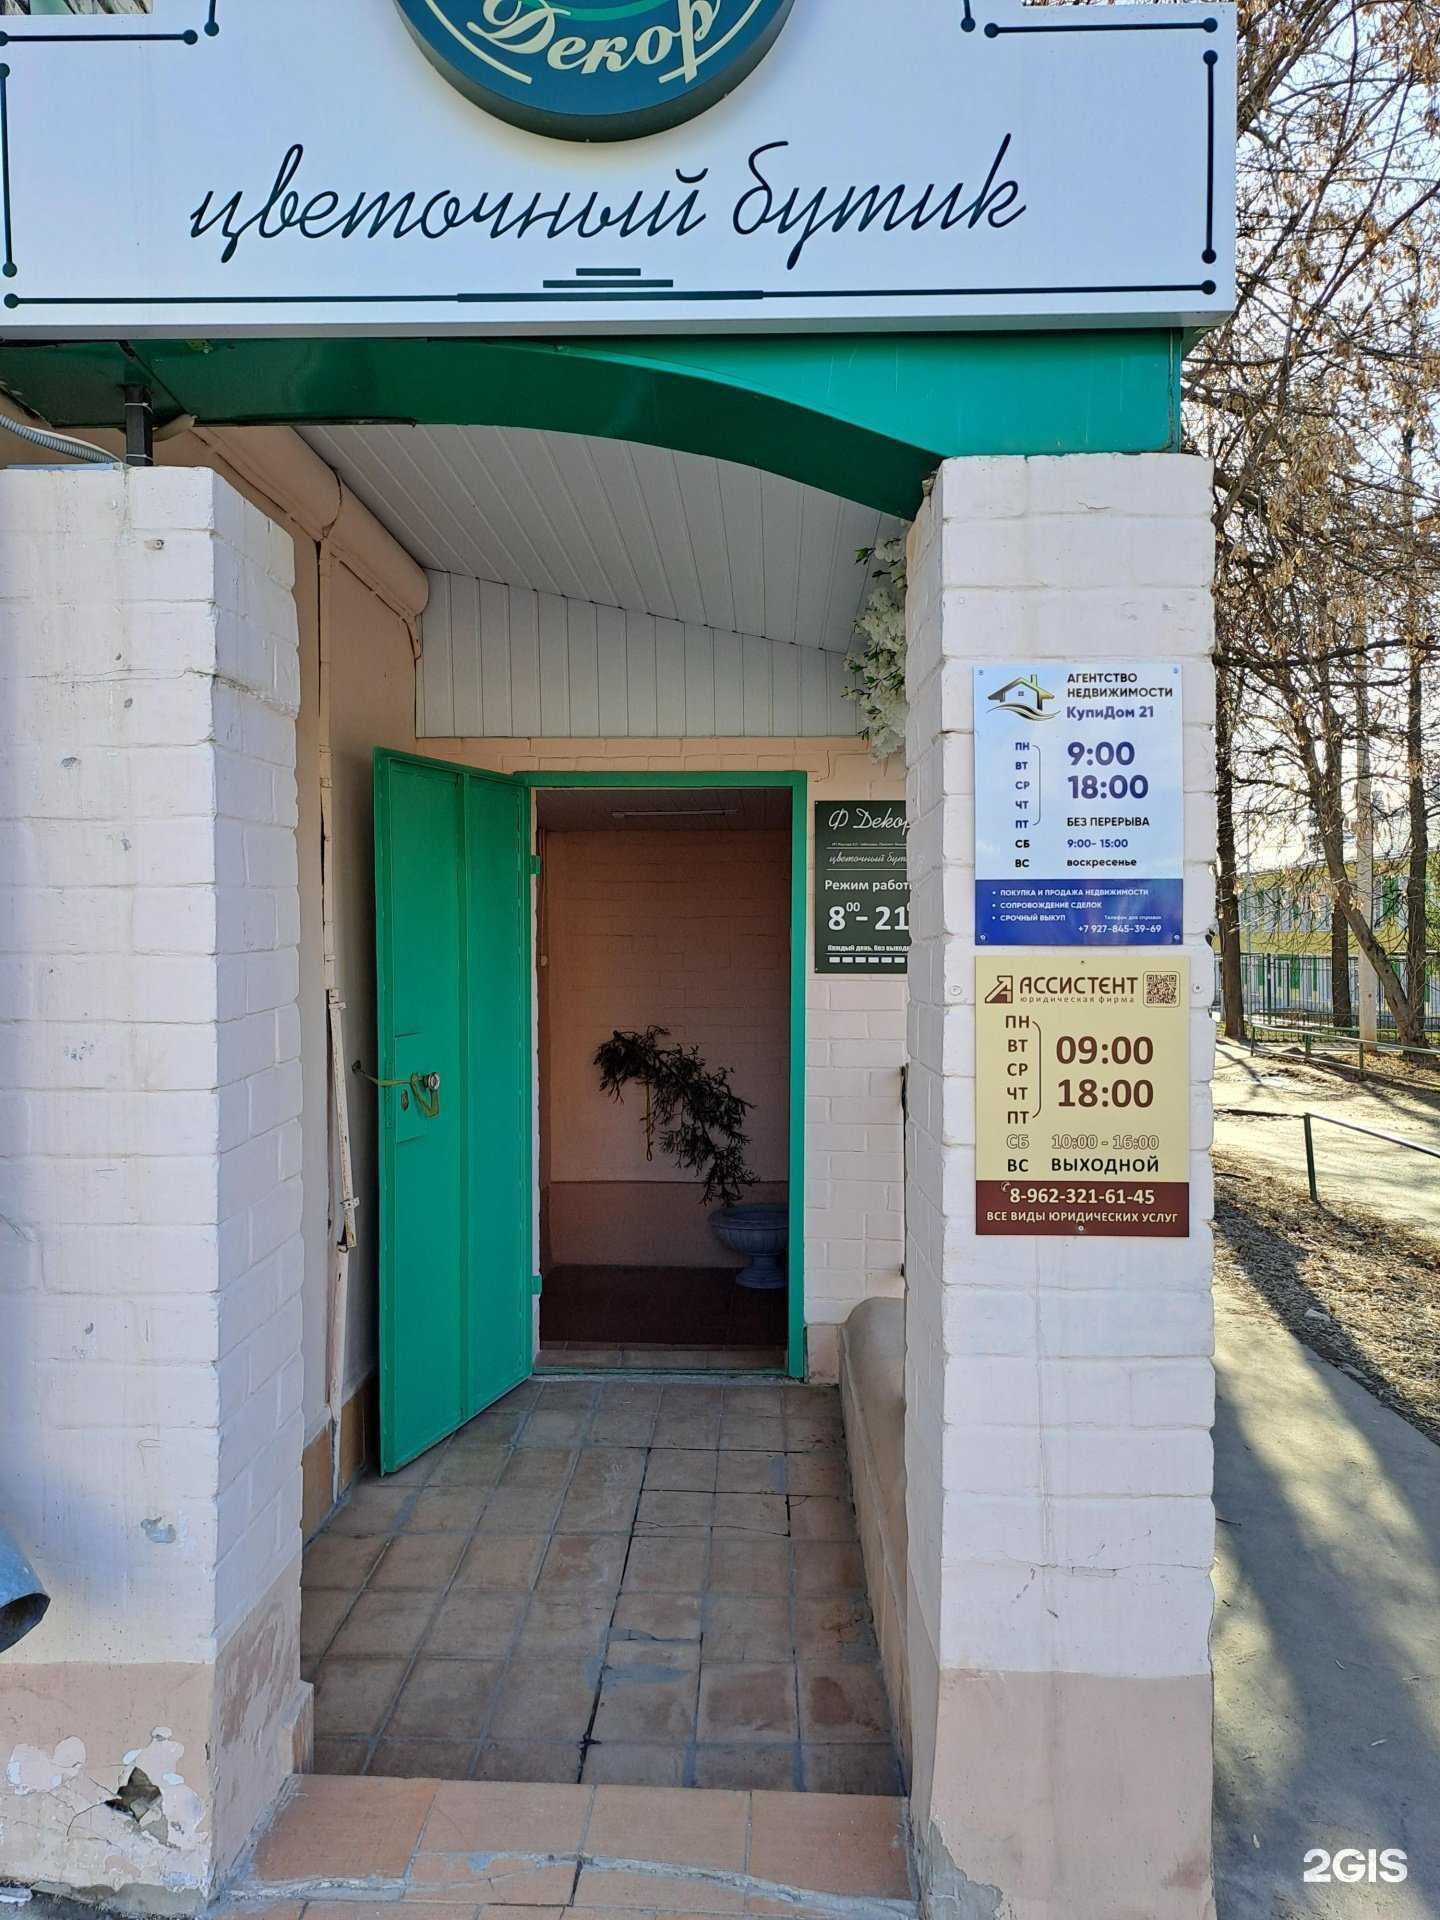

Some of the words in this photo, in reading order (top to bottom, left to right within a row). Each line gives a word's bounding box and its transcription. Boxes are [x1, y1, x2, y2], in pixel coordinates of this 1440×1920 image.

[467, 0, 722, 83] Декор
[190, 143, 707, 263] цветочный
[733, 132, 1027, 269] бутик
[1067, 672, 1138, 684] АГЕНТСТВО
[1067, 687, 1174, 699] НЕДВИЖИМОСТИ
[1066, 705, 1135, 721] КупиДом
[1138, 705, 1155, 718] 21
[1015, 742, 1030, 751] ПН
[1066, 741, 1136, 766] 9:00
[1015, 761, 1028, 770] ВТ
[1015, 781, 1030, 790] СР
[1066, 774, 1149, 800] 18:00
[1015, 800, 1029, 810] ЧТ
[828, 808, 849, 830] Ф
[1015, 820, 1029, 829] ПТ
[1066, 817, 1087, 827] БЕЗ
[1090, 817, 1150, 827] ПЕРЕРЫВА
[1015, 839, 1030, 849] СБ
[1100, 838, 1129, 849] 15:00
[829, 851, 886, 865] цветочный
[887, 851, 907, 866] бут
[1015, 859, 1030, 868] ВС
[1066, 858, 1137, 868] воскресенье
[825, 879, 869, 891] Режим
[872, 879, 912, 893] работ
[1000, 889, 1036, 897] ПОКУПКА
[1045, 889, 1083, 897] ПРОДАЖА
[1085, 888, 1149, 897] НЕДВИЖИМОСТИ
[1000, 901, 1069, 910] СОПРОВОЖДЕНИЕ
[1071, 901, 1103, 910] СДЕЛОК
[1000, 913, 1038, 922] СРОЧНЫЙ
[1039, 914, 1066, 922] ВЫКУП
[1078, 925, 1089, 933] +7
[1091, 924, 1162, 934] 927-845-39-69
[886, 944, 909, 953] выход
[1019, 976, 1138, 995] АССИСТЕНТ
[1020, 996, 1095, 1005] юридическая
[1098, 995, 1135, 1005] фирма
[1005, 1015, 1030, 1029] ПН
[1007, 1039, 1028, 1053] ВТ
[1056, 1036, 1154, 1065] 09:00
[1007, 1063, 1028, 1076] СР
[1007, 1087, 1028, 1101] ЧТ
[1057, 1079, 1154, 1108] 18:00
[1007, 1111, 1030, 1125] ПТ
[1006, 1134, 1030, 1149] СБ
[1051, 1134, 1098, 1150] 10:00
[1112, 1134, 1159, 1150] 16:00
[1007, 1158, 1029, 1173] ВС
[1051, 1155, 1159, 1175] ВЫХОДНОЙ
[1010, 1188, 1155, 1205] 8-962-321-61-45
[986, 1211, 1008, 1222] ВСЕ
[1010, 1211, 1046, 1222] ВИДЫ
[1048, 1211, 1138, 1223] ЮРИДИЧЕСКИХ
[1141, 1212, 1178, 1223] УСЛУГ
